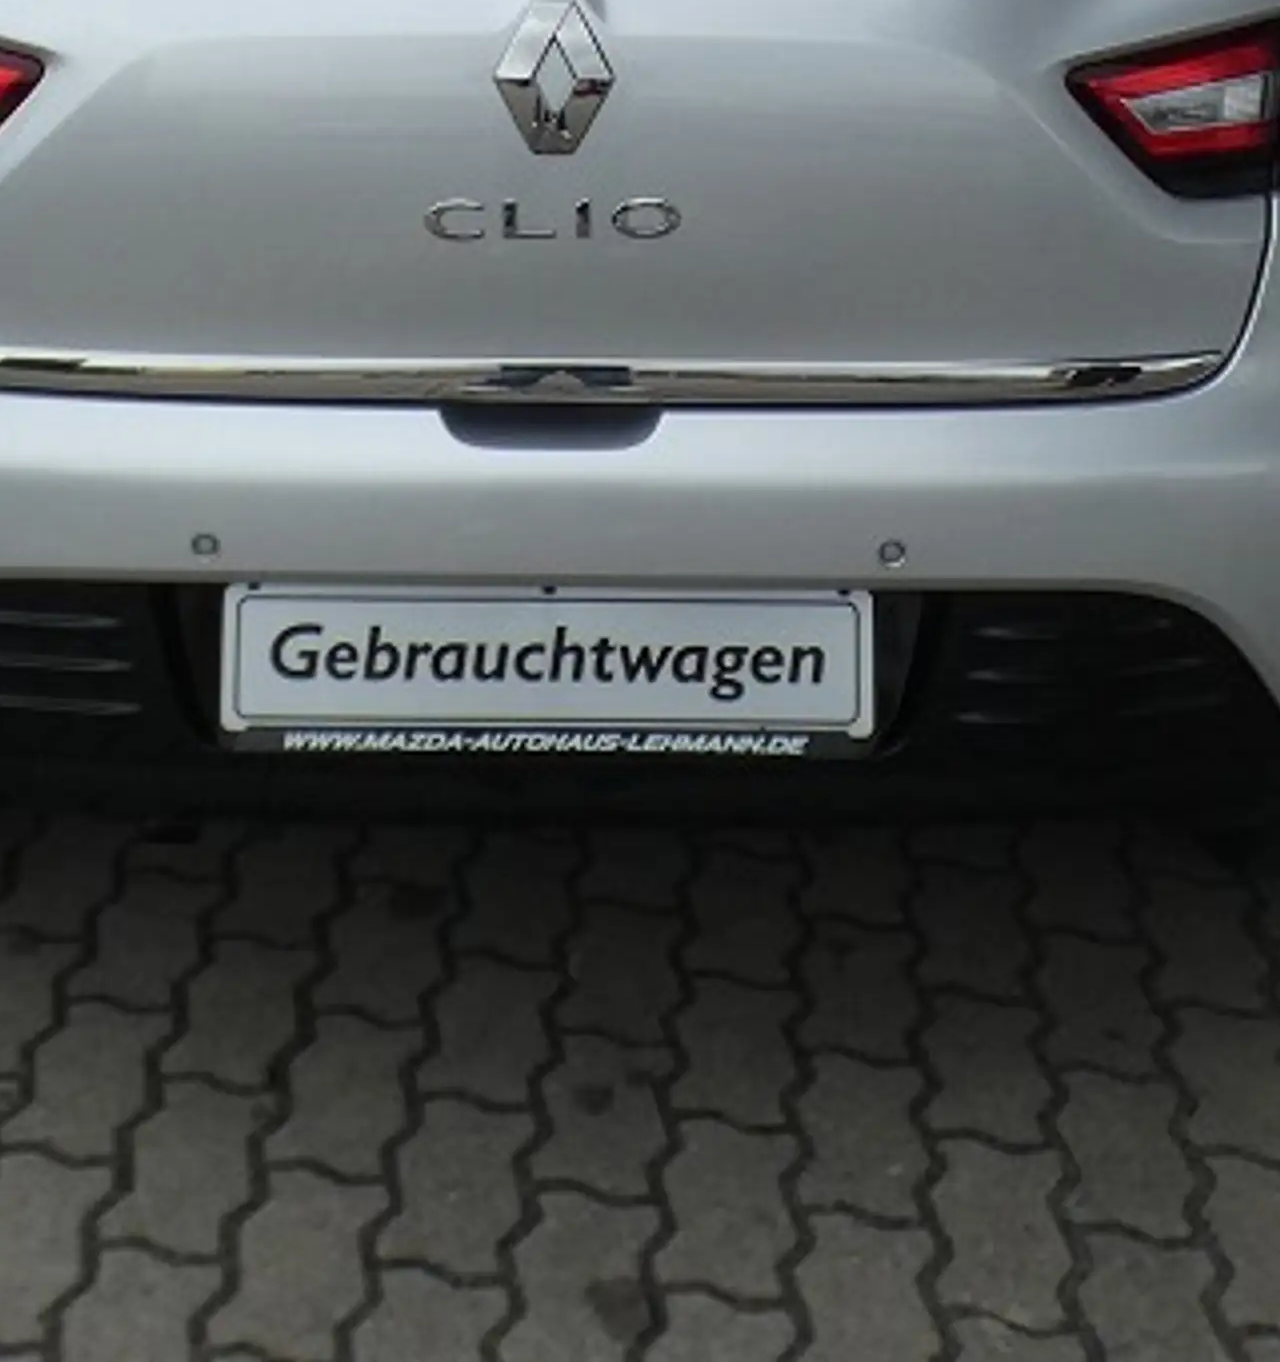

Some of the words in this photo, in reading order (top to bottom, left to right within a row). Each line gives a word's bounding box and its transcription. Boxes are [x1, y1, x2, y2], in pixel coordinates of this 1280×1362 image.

[423, 197, 683, 241] CLIO
[269, 624, 826, 701] Gebrauchtwagen
[281, 729, 811, 756] WWW.MAZDA-AUTOHAUS-LEHMANN.DE
